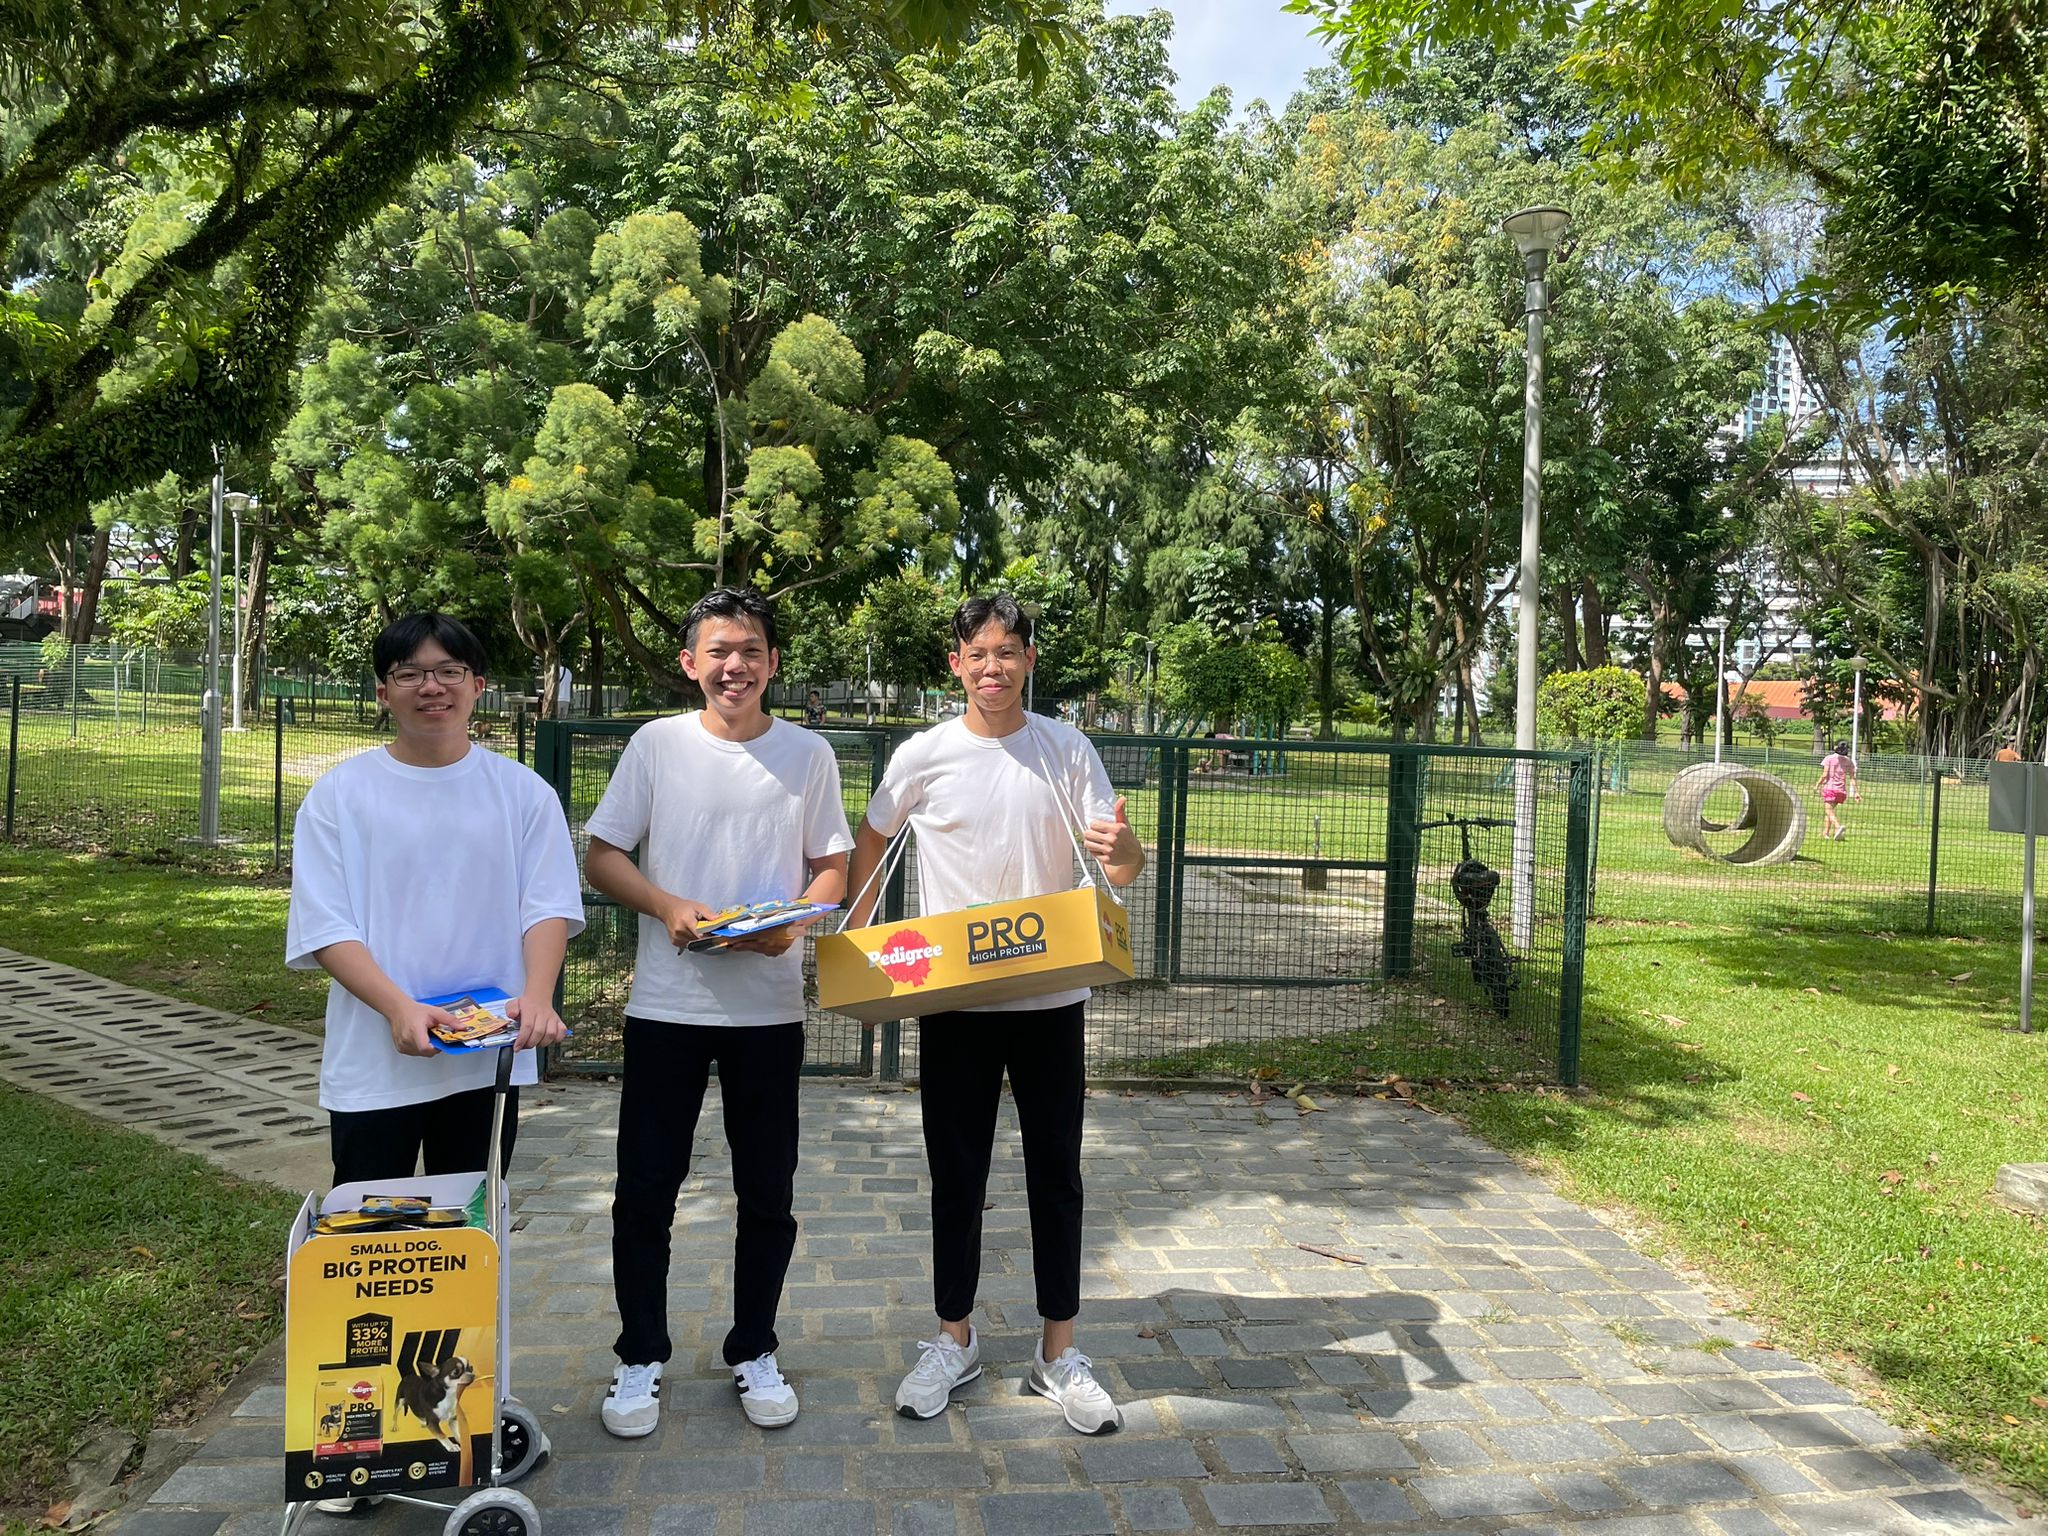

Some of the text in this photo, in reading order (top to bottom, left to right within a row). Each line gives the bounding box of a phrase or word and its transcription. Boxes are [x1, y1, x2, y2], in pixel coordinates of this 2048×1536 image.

[966, 911, 1046, 951] PRO
[867, 944, 944, 969] Pedigree
[971, 943, 1044, 963] HIGH PROTEIN
[350, 1240, 442, 1256] SMALL DOG.
[323, 1254, 467, 1279] BIG PROTEIN
[355, 1277, 434, 1298] NEEDS
[351, 1326, 388, 1341] 33%
[350, 1345, 389, 1355] PROTEIN
[356, 1339, 383, 1348] MORE
[350, 1402, 375, 1412] PRO
